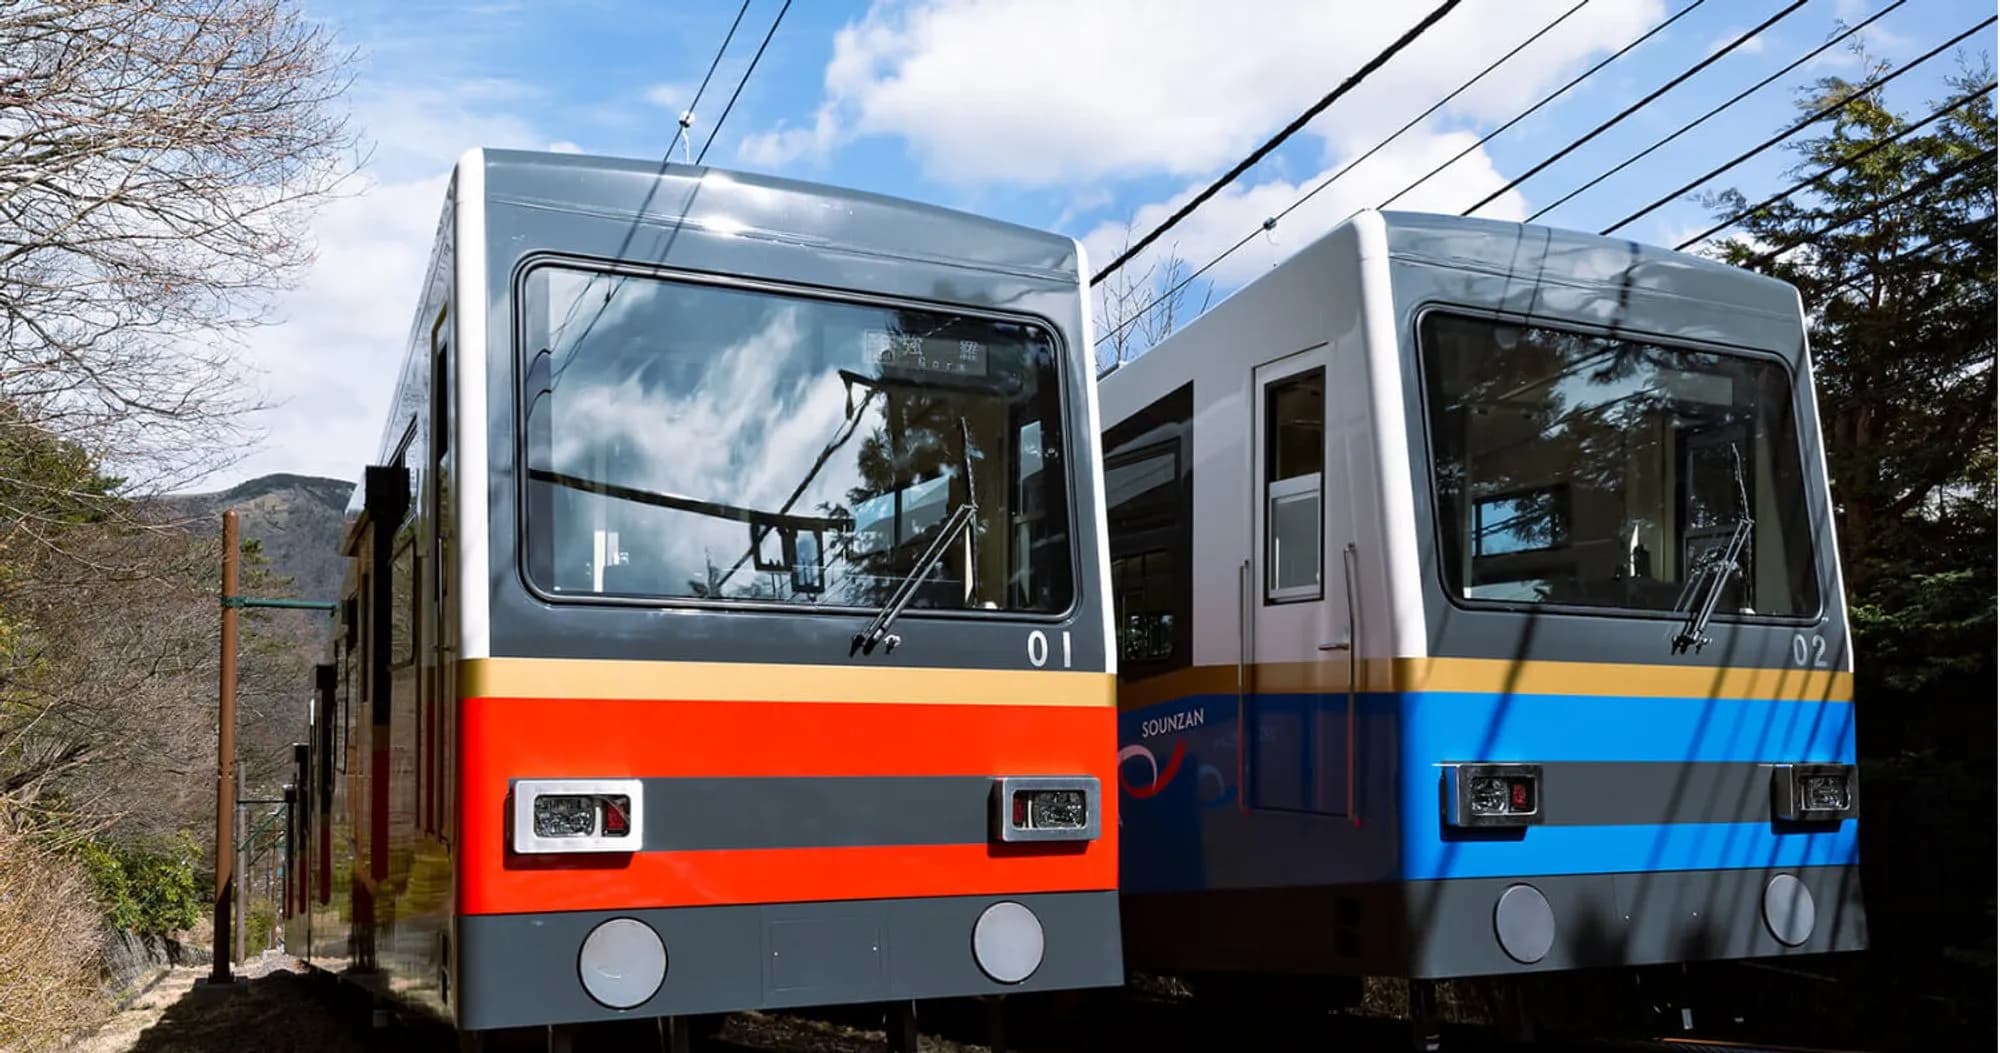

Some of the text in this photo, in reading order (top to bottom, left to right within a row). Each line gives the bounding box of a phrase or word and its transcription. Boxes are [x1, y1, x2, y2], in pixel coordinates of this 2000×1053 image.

[1027, 630, 1071, 668] 01
[1793, 634, 1828, 667] 02
[1142, 708, 1204, 738] SOUNZAN
